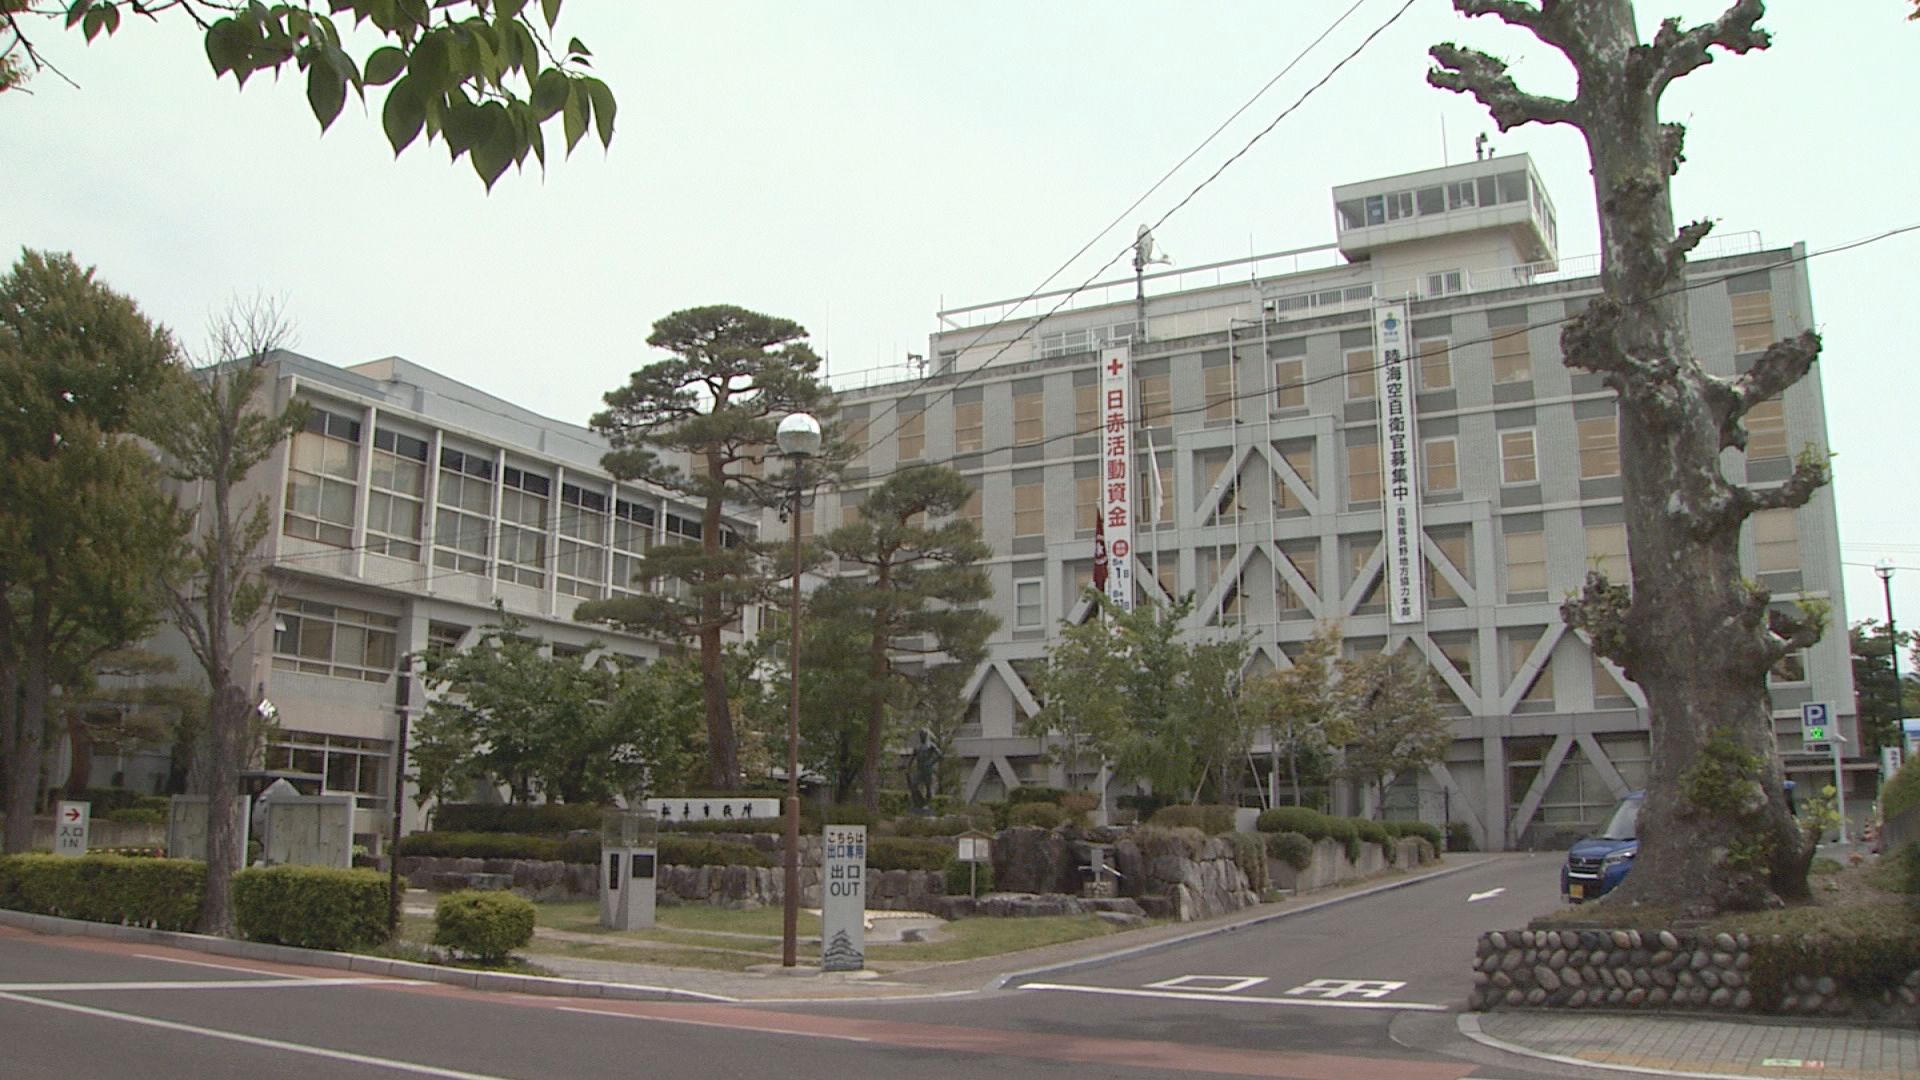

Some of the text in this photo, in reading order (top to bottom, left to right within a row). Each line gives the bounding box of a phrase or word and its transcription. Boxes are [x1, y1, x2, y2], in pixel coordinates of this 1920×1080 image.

[1384, 348, 1409, 501] 陸海空自衛官募集中
[1106, 389, 1127, 527] 日赤活動資金
[1806, 705, 1823, 726] P
[60, 826, 84, 837] 入口
[828, 831, 864, 844] こちらは
[63, 838, 80, 848] IN
[828, 845, 864, 858] 出口専用
[831, 864, 861, 879] 出口
[830, 881, 860, 896] OUT
